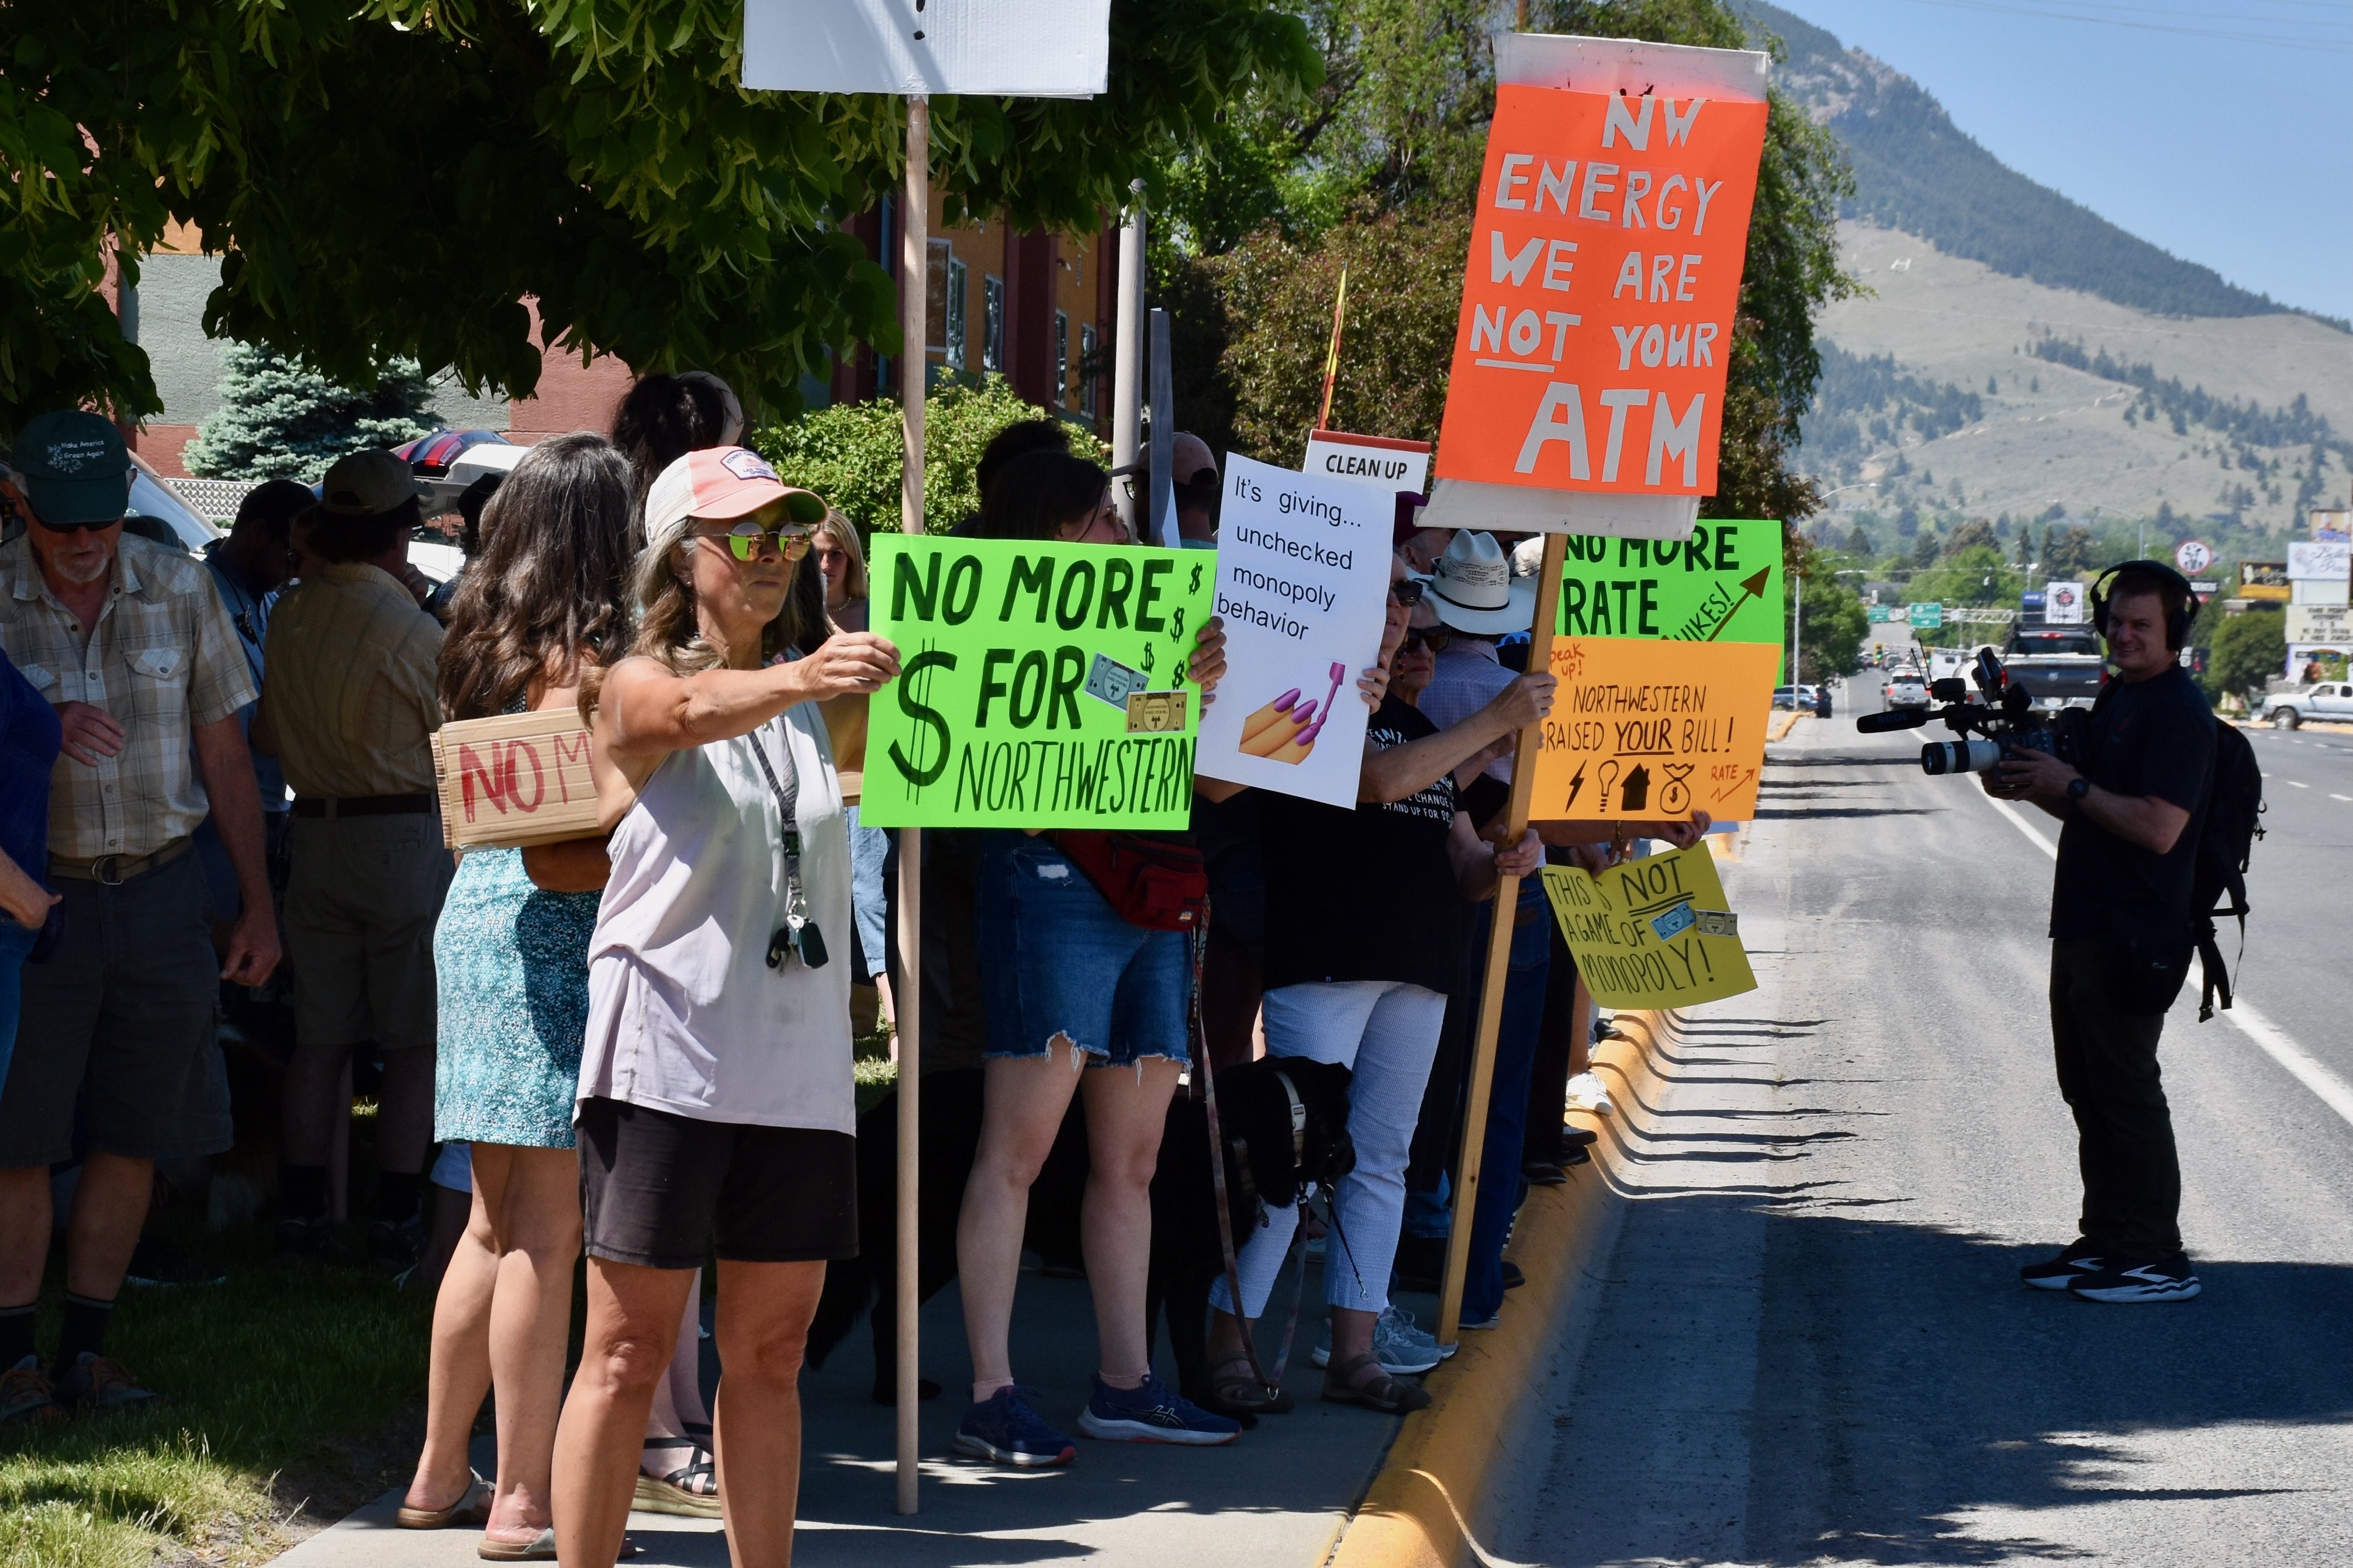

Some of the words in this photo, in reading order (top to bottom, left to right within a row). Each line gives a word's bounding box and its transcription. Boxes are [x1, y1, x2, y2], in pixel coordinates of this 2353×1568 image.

[1601, 91, 1708, 151] NW
[1495, 154, 1723, 236] ENERGY
[1491, 231, 1578, 292] WE
[1613, 252, 1702, 302] ARE
[1470, 304, 1581, 362] NOT
[1612, 322, 1718, 371] YOUR
[87, 450, 104, 458] Again
[1514, 382, 1706, 486] ATM
[1326, 454, 1380, 479] CLEAN
[1384, 460, 1407, 480] UP
[1235, 475, 1262, 503] It's
[1279, 491, 1362, 527] giving...
[1236, 525, 1353, 570] unchecked
[1564, 534, 1606, 563] NO
[1619, 525, 1739, 572] MORE
[891, 552, 983, 626] NO
[998, 555, 1174, 633] MORE
[1233, 565, 1336, 612] monopoly
[1563, 578, 1659, 636] RATE
[1217, 593, 1309, 641] behavior
[1550, 642, 1585, 670] peak
[1561, 658, 1582, 681] up!
[887, 637, 957, 805] $
[975, 645, 1086, 729] FOR
[1573, 684, 1706, 714] NORTHWESTERN
[1546, 721, 1604, 753] RAISED
[1613, 718, 1673, 752] YOUR
[459, 740, 545, 823] NO
[954, 736, 1197, 814] NORTHWESTERN
[1711, 764, 1739, 781] RATE
[1383, 802, 1409, 814] STAND
[1410, 806, 1421, 816] UP
[1423, 808, 1439, 819] FOR
[1415, 793, 1450, 808] CHANGE
[1544, 873, 1591, 906] THIS
[1594, 881, 1612, 911] S
[1620, 856, 1681, 906] NOT
[1621, 919, 1646, 947] OF
